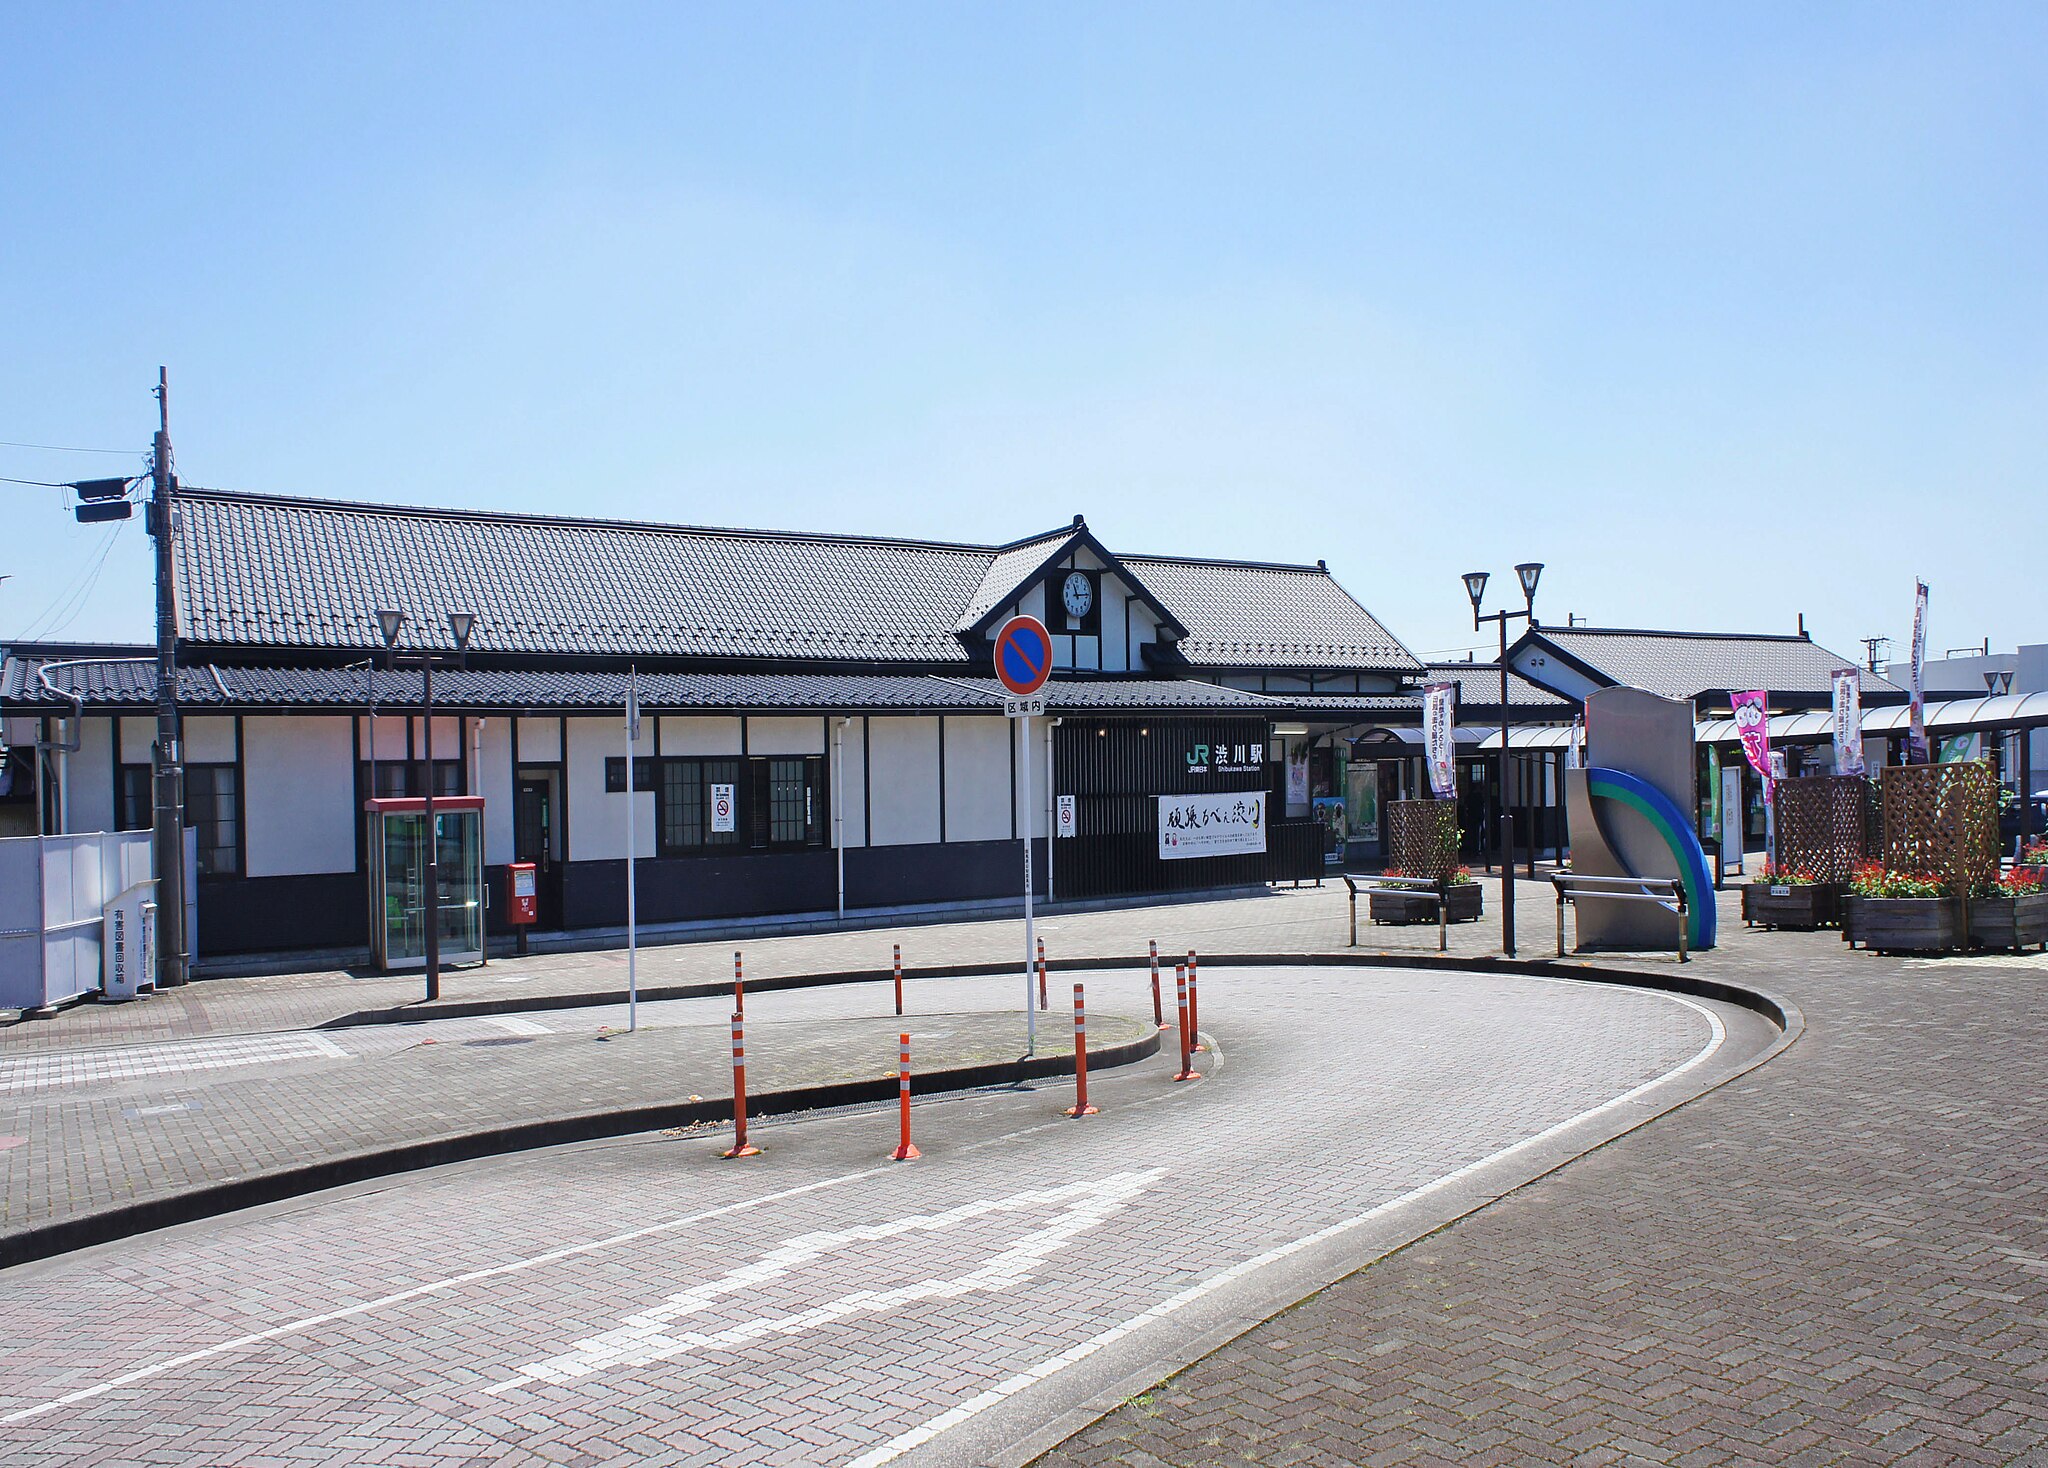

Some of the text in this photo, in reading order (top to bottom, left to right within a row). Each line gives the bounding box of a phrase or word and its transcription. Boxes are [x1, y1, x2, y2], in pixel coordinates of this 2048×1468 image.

[1007, 700, 1041, 713] 区域内
[1187, 744, 1209, 764] JR
[1215, 744, 1263, 764] 渋川駅
